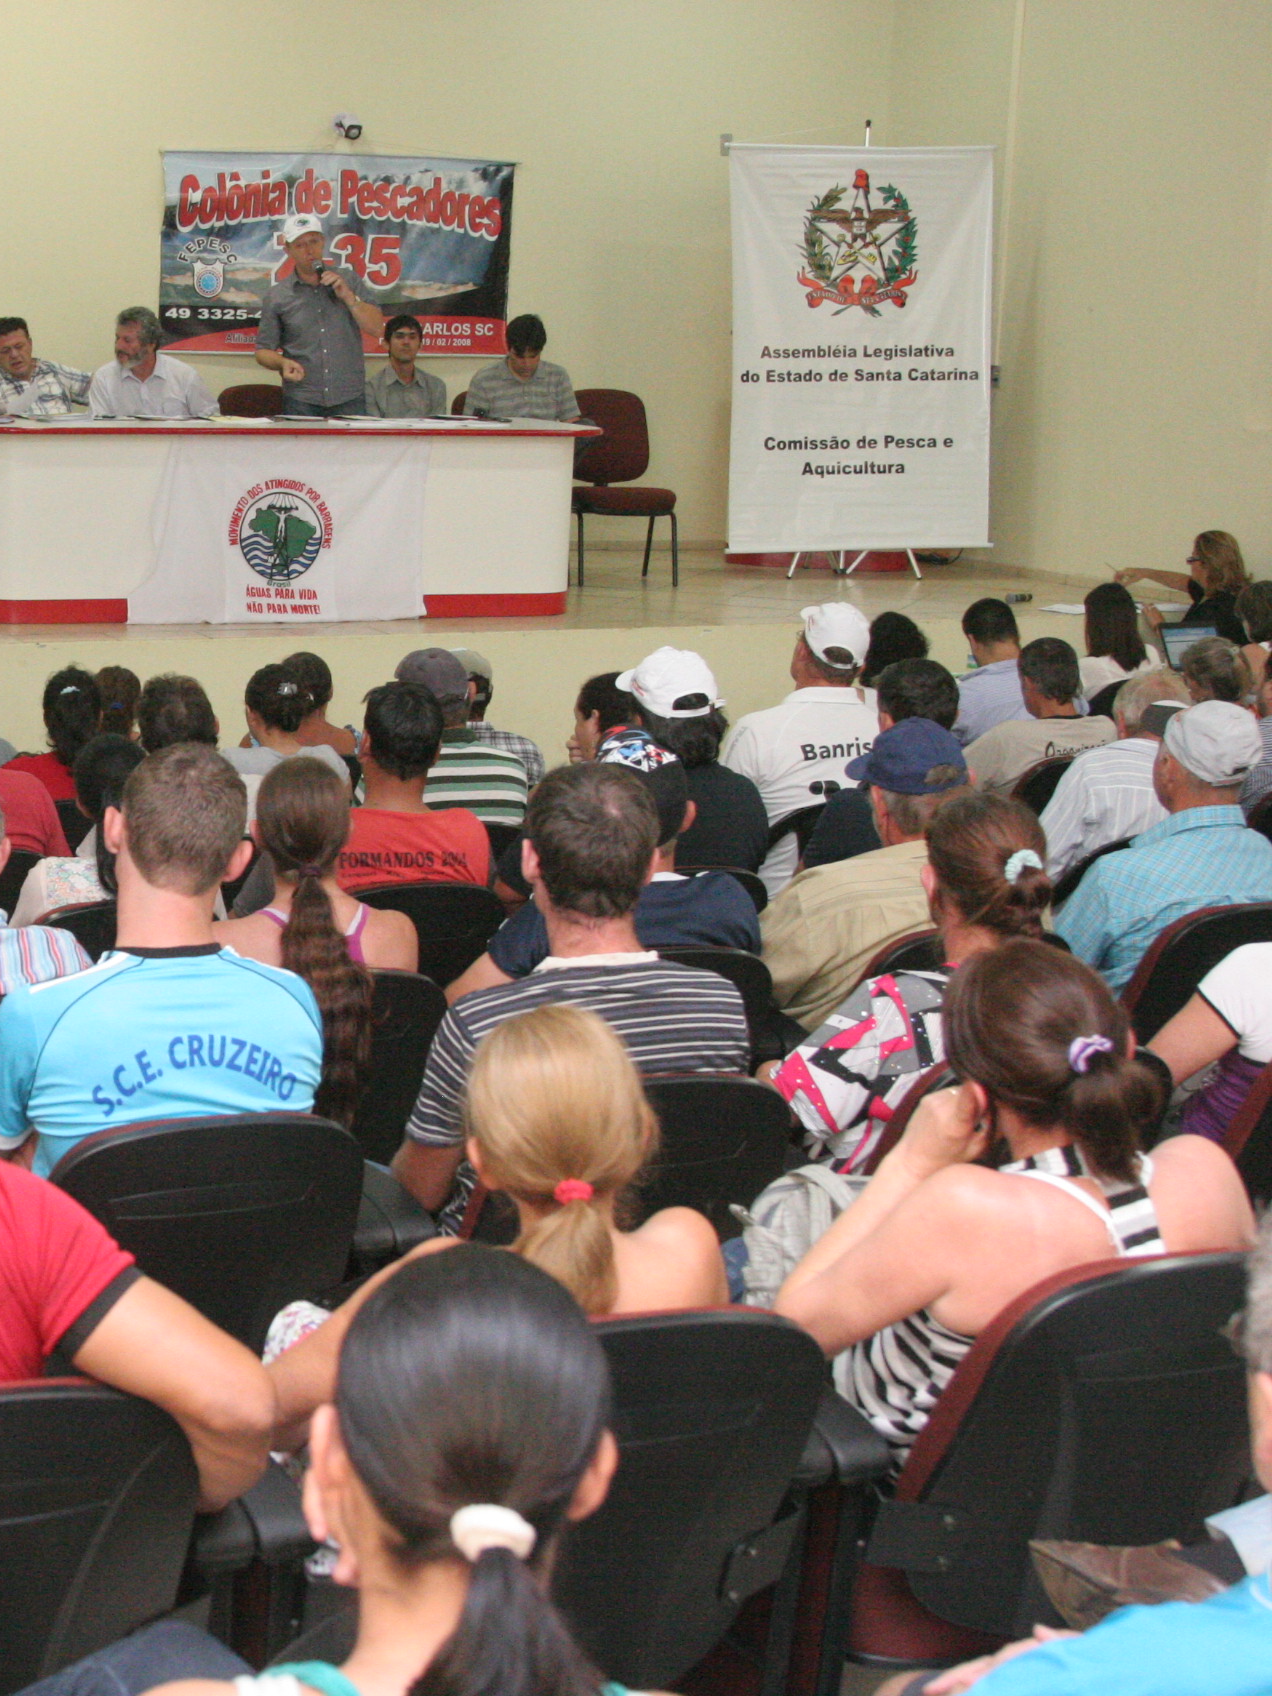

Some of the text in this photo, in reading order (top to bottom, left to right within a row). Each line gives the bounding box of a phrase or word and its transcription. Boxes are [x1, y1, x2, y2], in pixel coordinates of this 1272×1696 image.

[177, 168, 502, 241] Colônia de Pescadores
[178, 237, 237, 263] FEPESC
[165, 307, 191, 319] 49
[420, 323, 494, 336] ARLOS SC
[436, 338, 446, 346] 02
[453, 338, 472, 346] 2008
[760, 344, 954, 360] Assembléia Legislativa
[740, 367, 979, 383] do Estado de Santa Catarina
[764, 435, 954, 451] Comissão de Pesca e
[801, 461, 905, 478] Aquicultura
[228, 479, 334, 549] MOVIMENTO DOS ATINGIDOS POR BARRAGENS
[274, 588, 295, 600] PARA
[298, 588, 318, 600] VIDA
[246, 601, 263, 614] NÃO
[268, 602, 288, 614] PARA
[800, 737, 874, 761] Banris
[340, 851, 434, 869] FORMANDOS
[92, 1034, 297, 1117] S.C.E. CRUZEIRO
